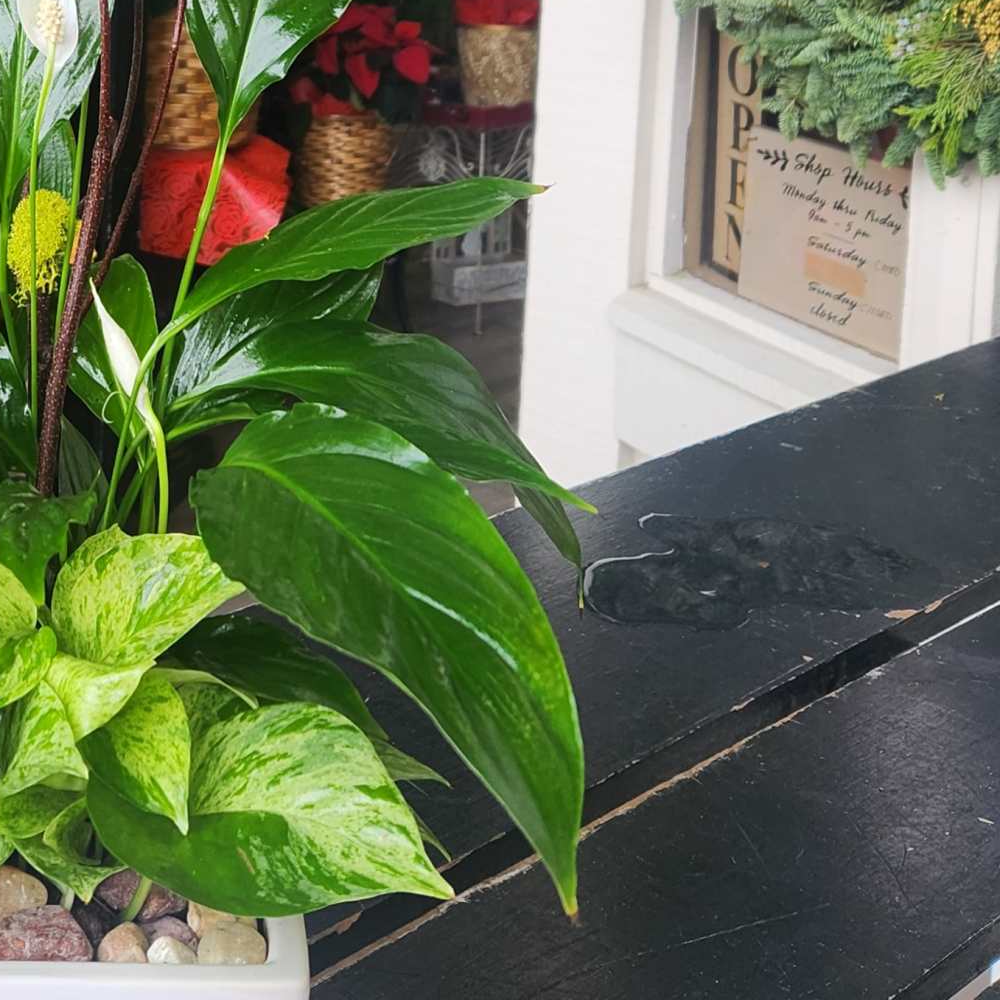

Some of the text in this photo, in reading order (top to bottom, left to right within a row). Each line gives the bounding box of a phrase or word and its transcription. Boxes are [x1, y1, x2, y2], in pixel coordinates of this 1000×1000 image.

[793, 152, 893, 197] Shop Hours
[782, 182, 902, 235] Monday thru Friday
[807, 235, 866, 268] Saturday
[807, 281, 857, 311] Sunday
